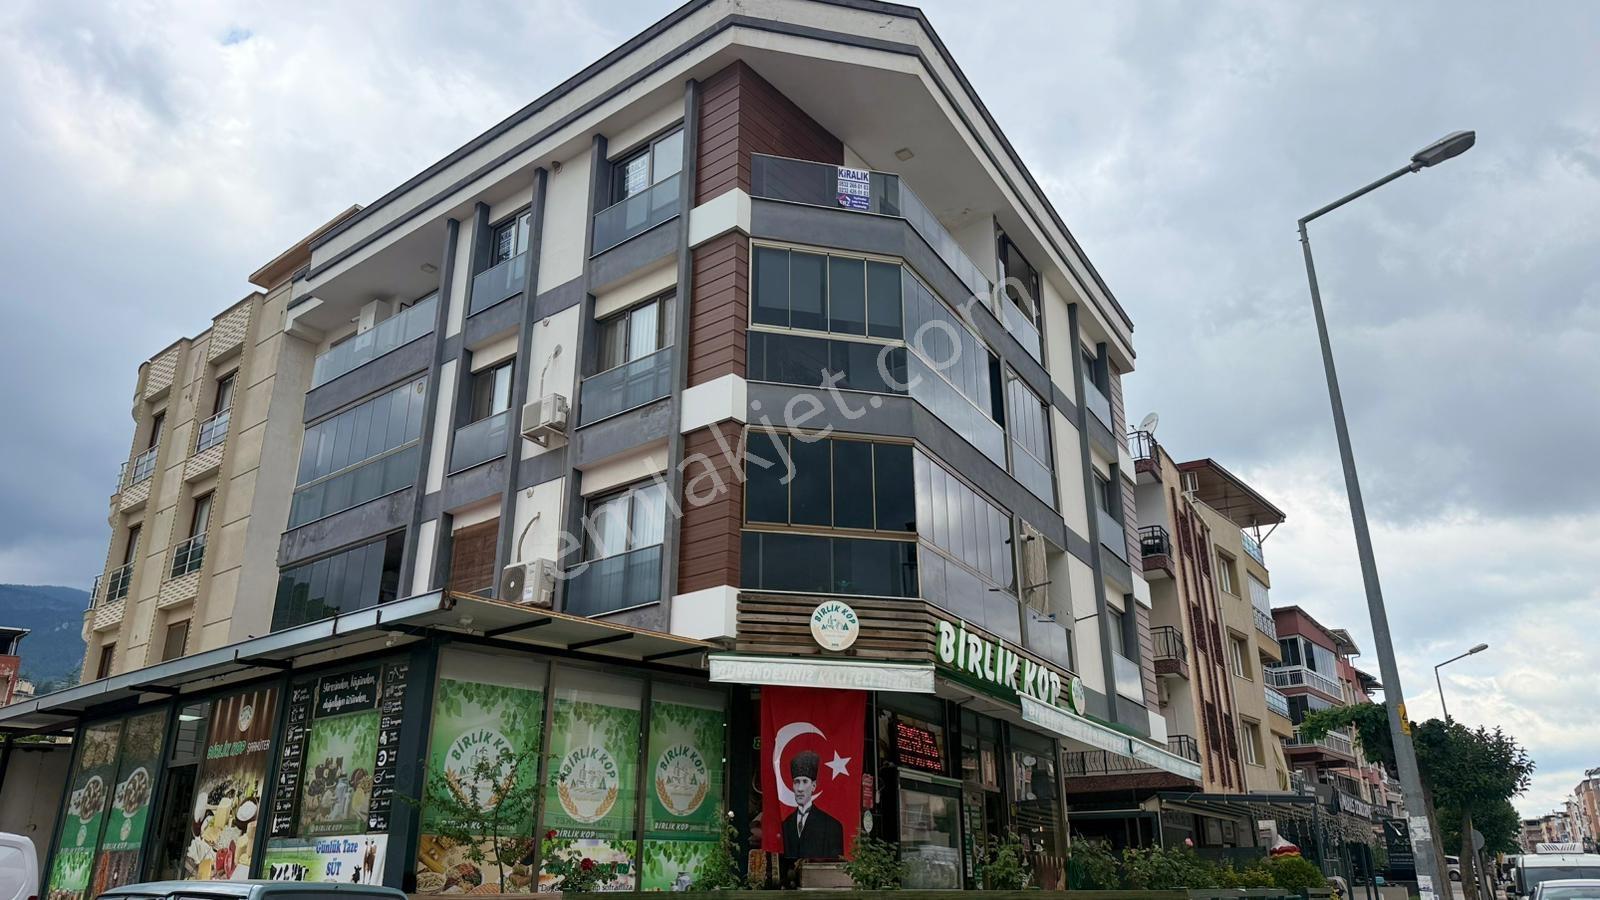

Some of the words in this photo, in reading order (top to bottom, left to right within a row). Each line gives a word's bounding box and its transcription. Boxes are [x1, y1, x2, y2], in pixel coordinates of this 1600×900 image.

[814, 603, 841, 622] BİRLİK
[841, 608, 857, 624] KOP
[938, 619, 1018, 690] BİRLİK
[1024, 659, 1061, 706] KOP
[451, 728, 493, 761] BİRLİK
[660, 743, 690, 770] BİRLİK
[690, 752, 704, 775] KOP
[564, 746, 599, 774] BİRLİK
[599, 753, 616, 778] KOP
[316, 840, 341, 853] Günlük
[343, 839, 359, 853] Taze
[326, 857, 341, 876] SÜT
